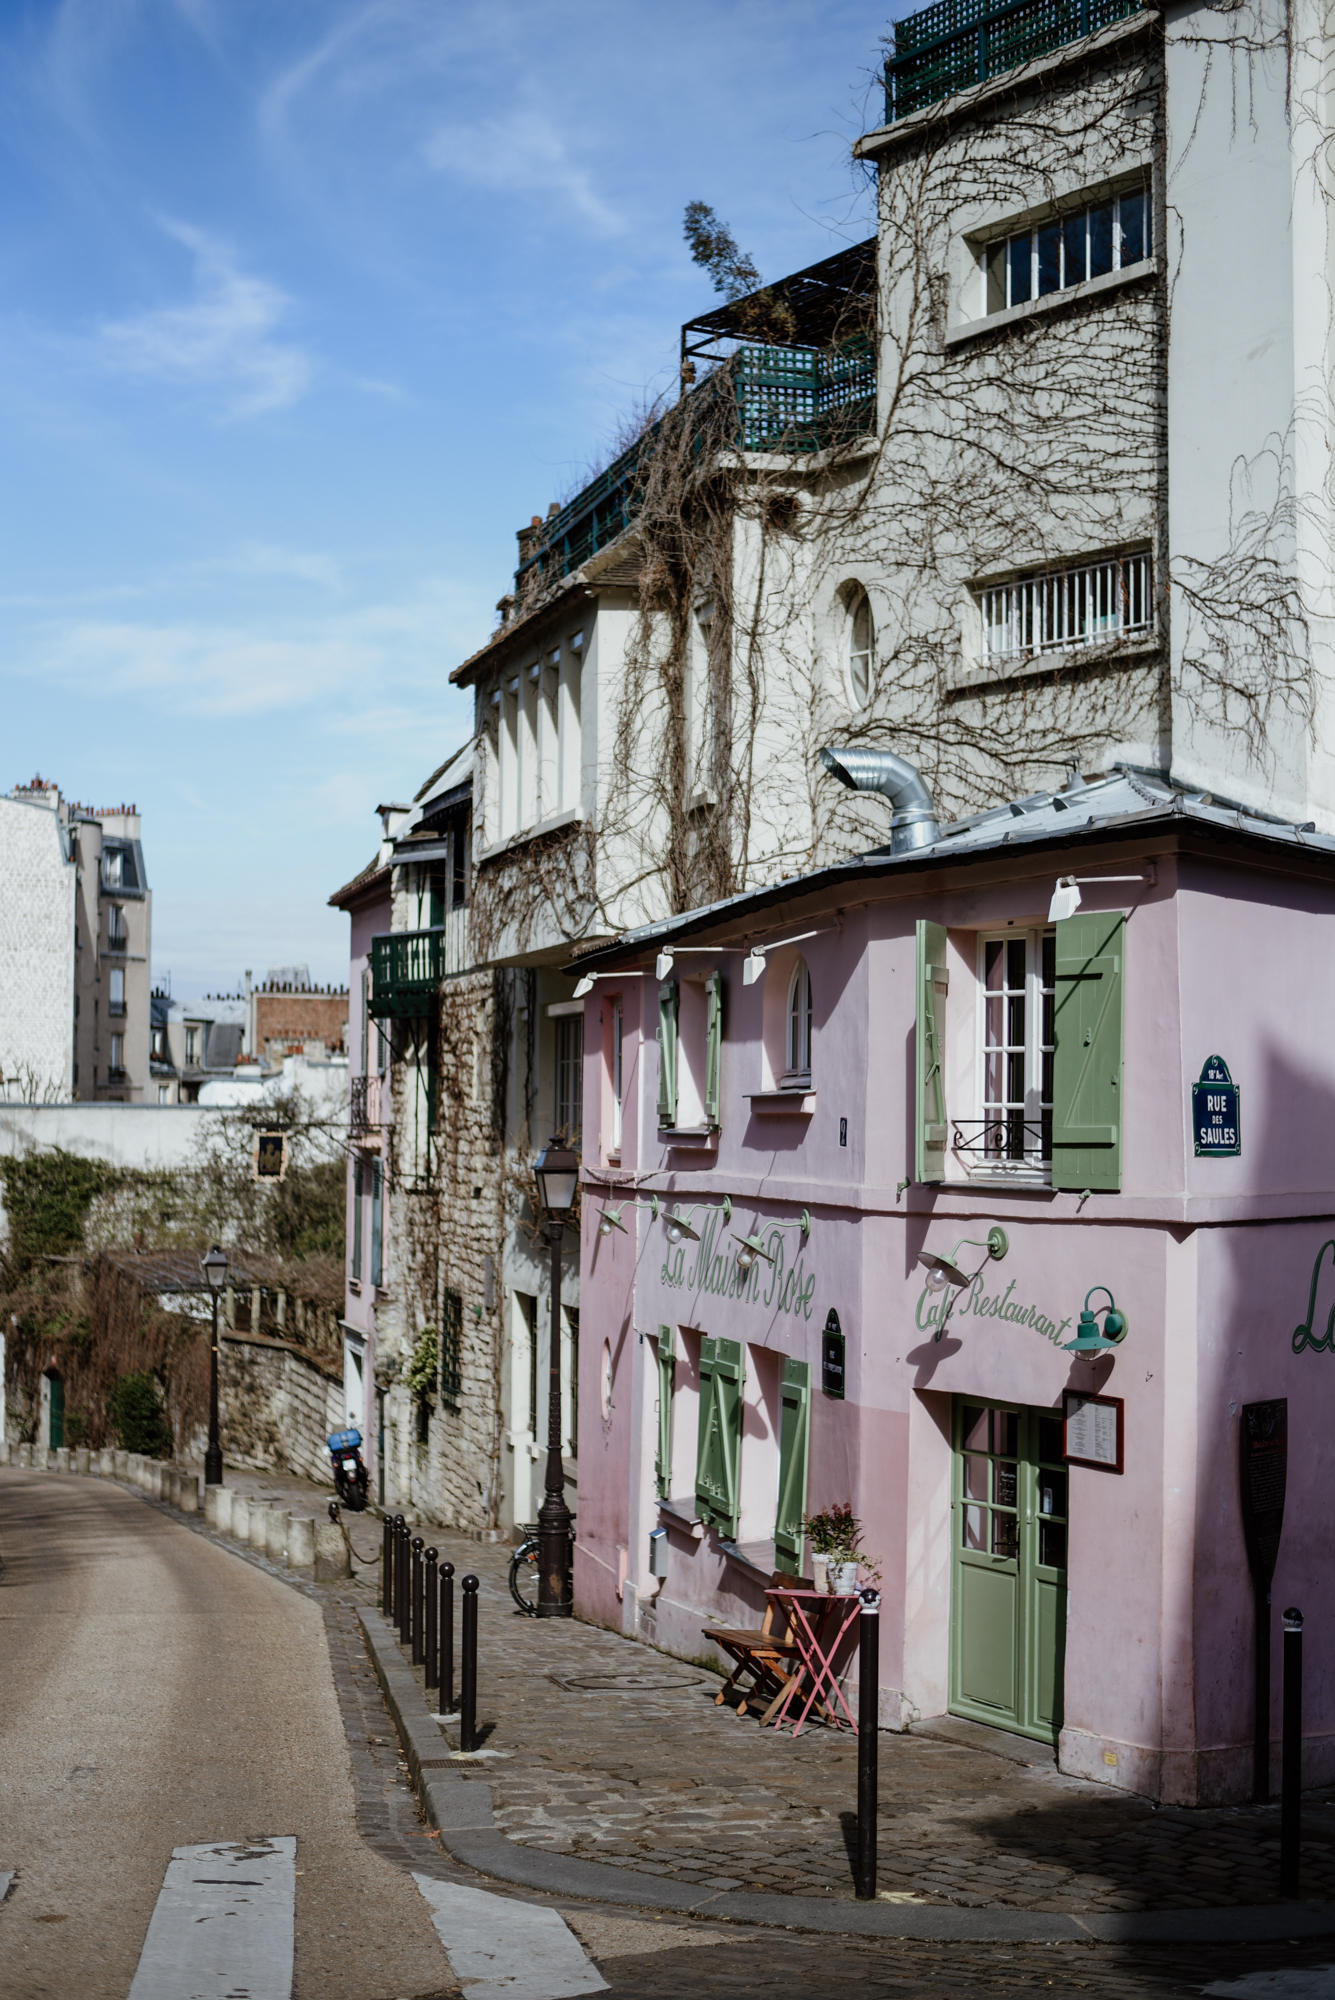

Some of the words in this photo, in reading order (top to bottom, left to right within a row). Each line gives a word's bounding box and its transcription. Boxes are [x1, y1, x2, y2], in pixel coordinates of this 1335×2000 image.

[1207, 1095, 1227, 1112] RUE
[1211, 1115, 1223, 1125] DES
[1200, 1128, 1236, 1145] SAULES
[661, 1204, 686, 1287] La
[687, 1207, 760, 1304] Maison
[764, 1230, 816, 1321] Rose
[914, 1283, 955, 1341] Café
[958, 1271, 1073, 1347] Restaurant
